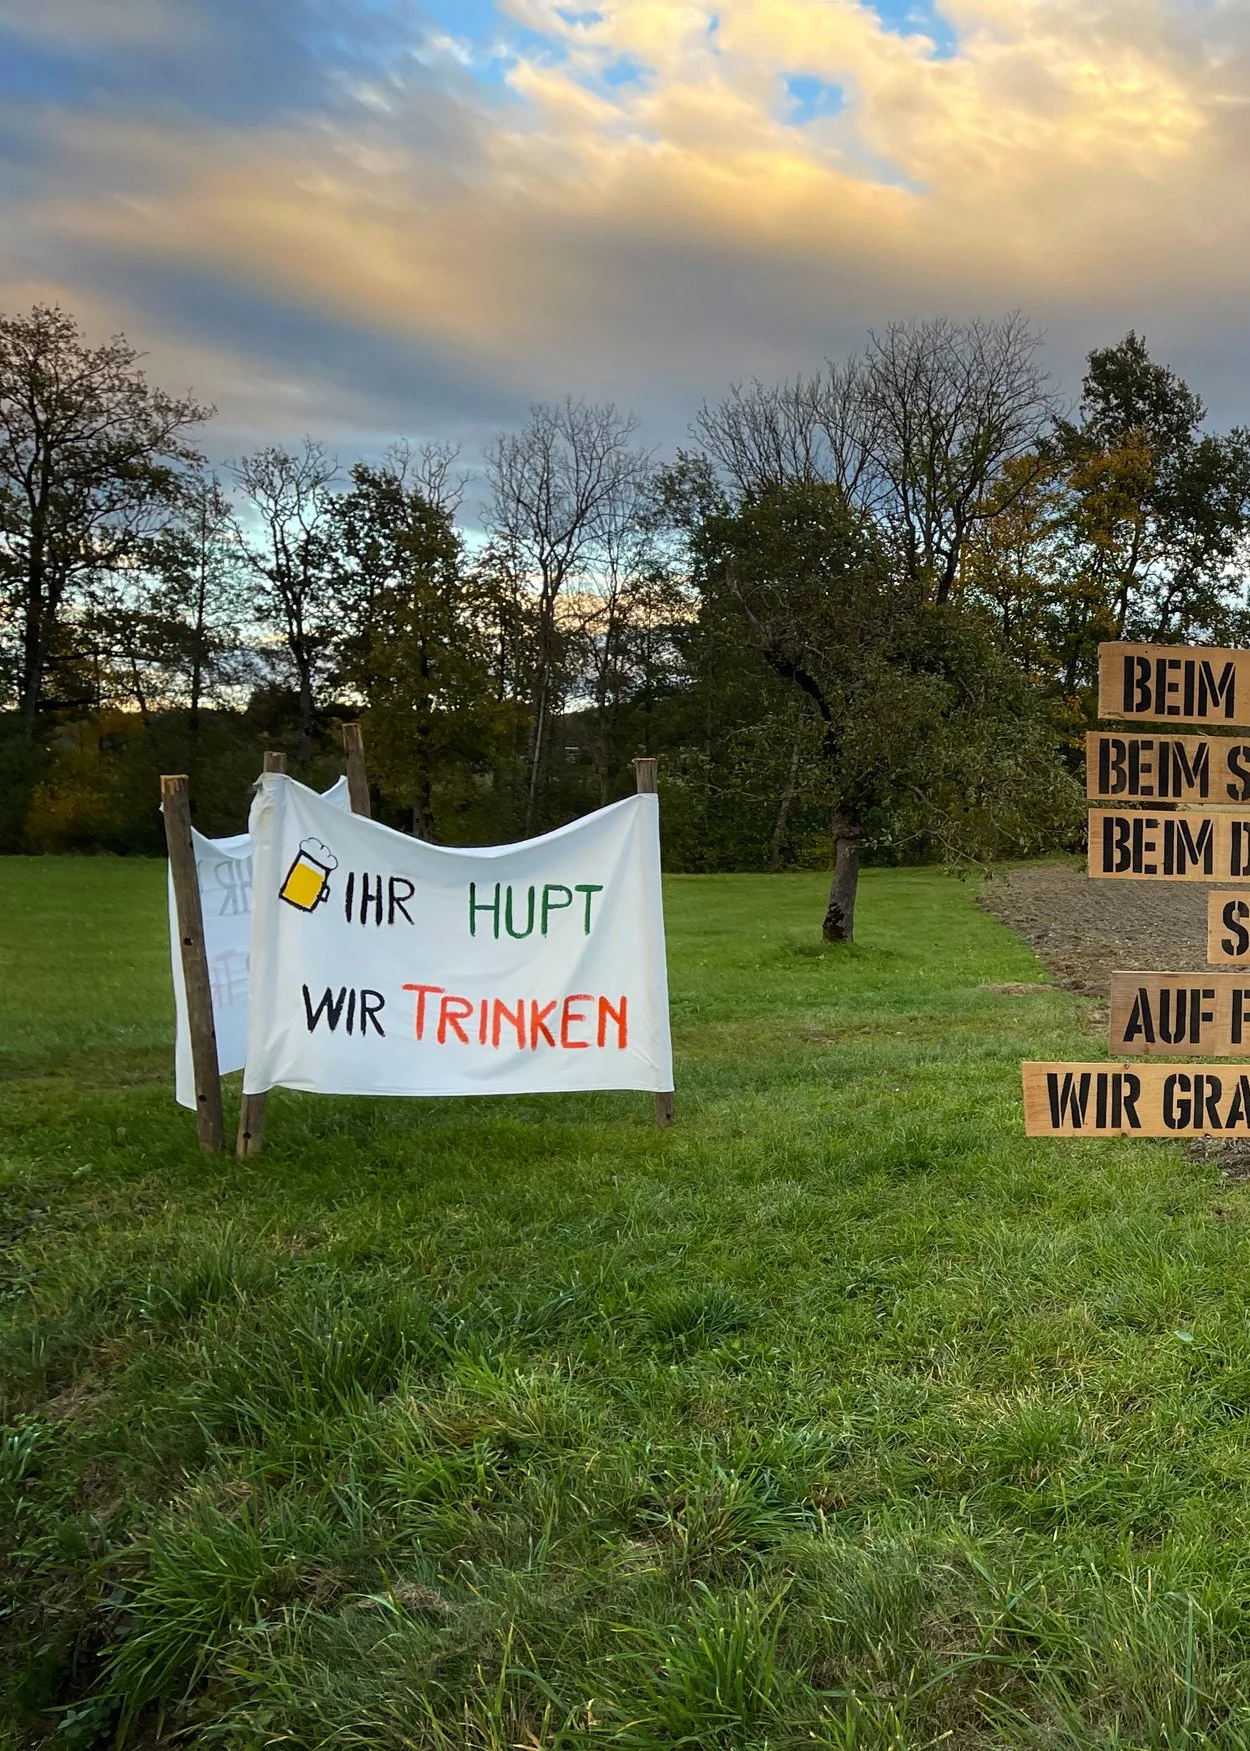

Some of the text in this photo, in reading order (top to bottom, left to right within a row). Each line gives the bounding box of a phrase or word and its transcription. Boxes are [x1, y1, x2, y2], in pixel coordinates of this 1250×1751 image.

[1122, 656, 1235, 718] BEIM
[1099, 738, 1209, 798] BEIM
[1103, 817, 1213, 875] BEIM
[346, 872, 603, 938] IHR HUPT
[303, 984, 628, 1051] WIR TRINKEN
[1123, 988, 1214, 1044] AUF
[1047, 1073, 1141, 1128] WIR
